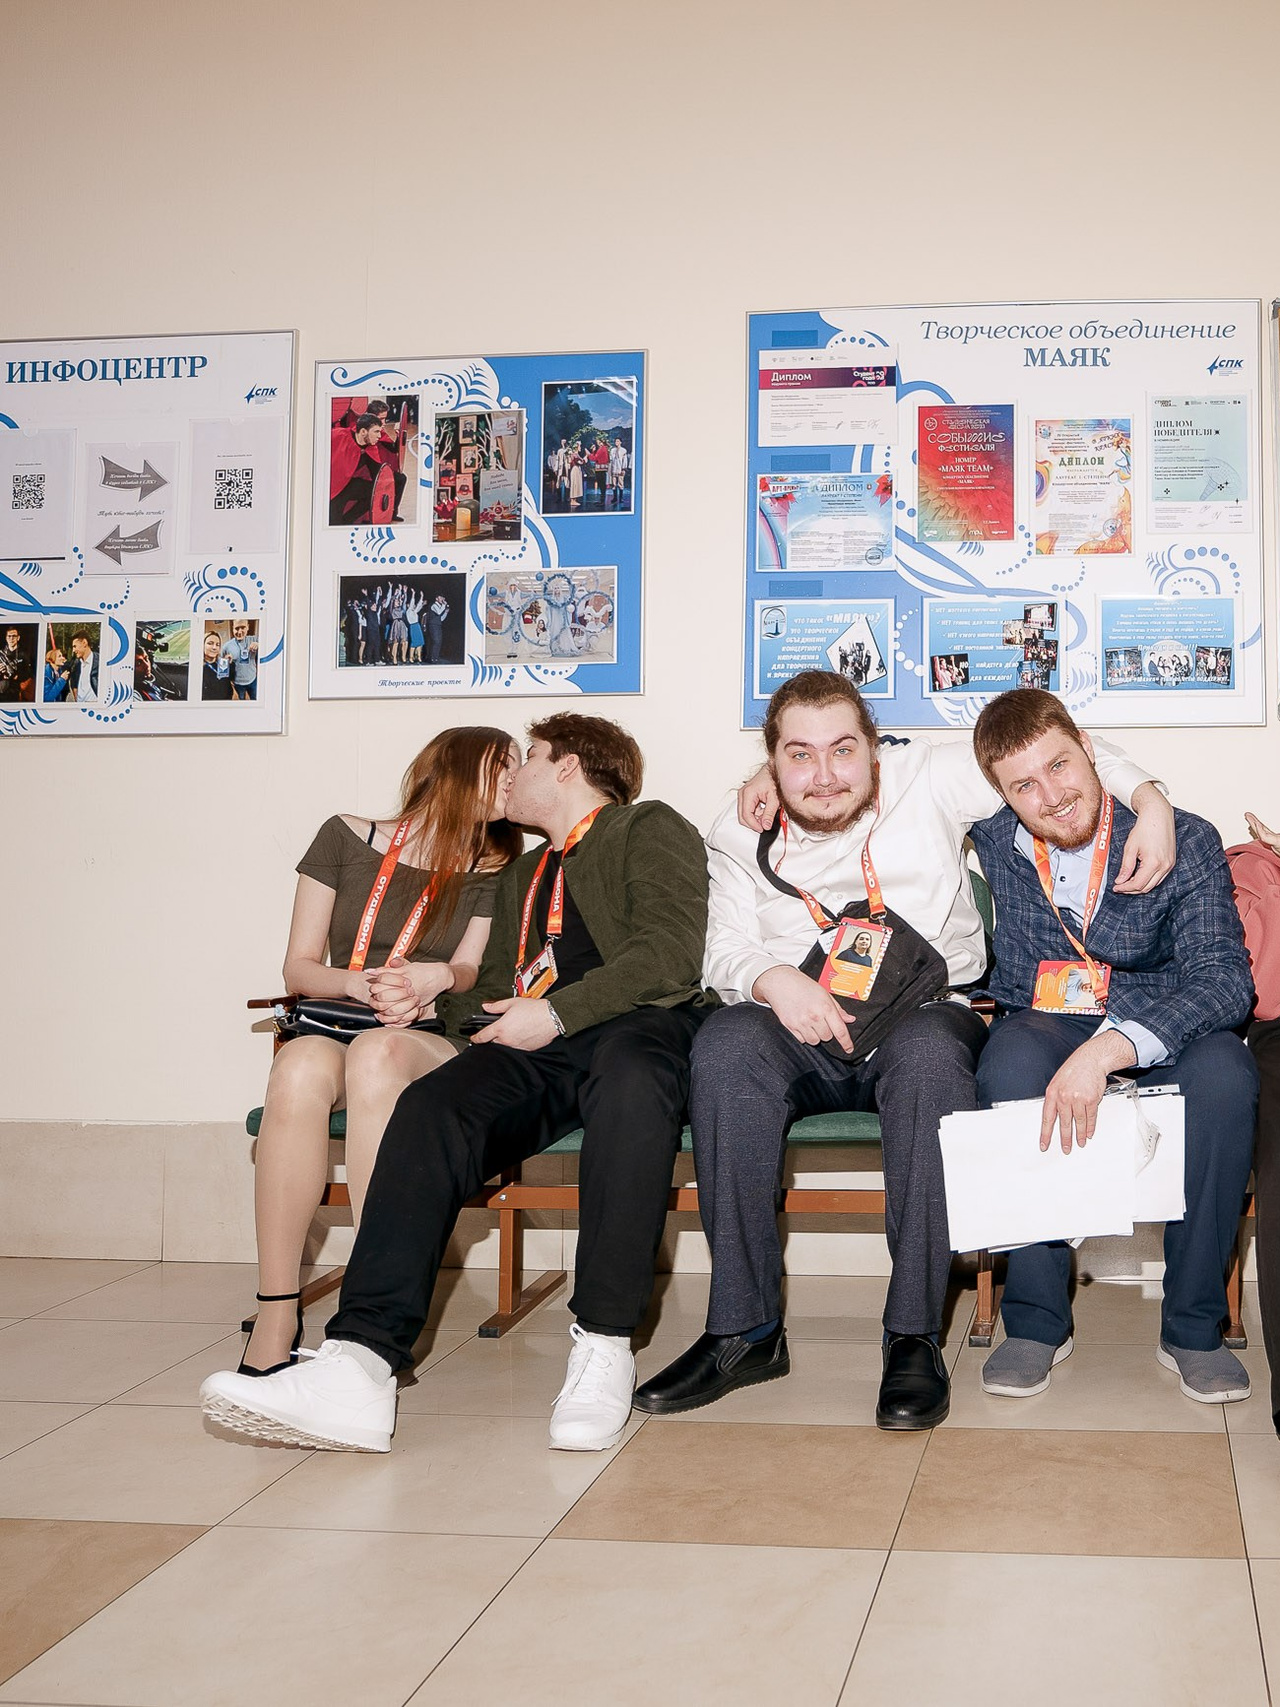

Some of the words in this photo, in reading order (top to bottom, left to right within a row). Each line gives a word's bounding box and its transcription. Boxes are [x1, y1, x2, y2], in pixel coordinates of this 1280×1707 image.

[921, 320, 1063, 345] Творческое
[1069, 318, 1236, 340] объединение
[1023, 347, 1111, 367] МАЯК
[1217, 358, 1244, 368] СПК
[5, 355, 208, 386] ИНФОЦЕНТР
[771, 372, 812, 382] Диплом
[255, 387, 278, 396] СПК
[1154, 420, 1193, 428] ДИПЛОМ
[1154, 429, 1212, 437] ПОБЕДИТЕЛЯ
[938, 444, 995, 452] ФЕСТИВАЛЯ
[1059, 457, 1105, 467] ДИПЛОМ
[820, 483, 864, 492] ДИПЛОМ
[378, 680, 425, 688] Творческие
